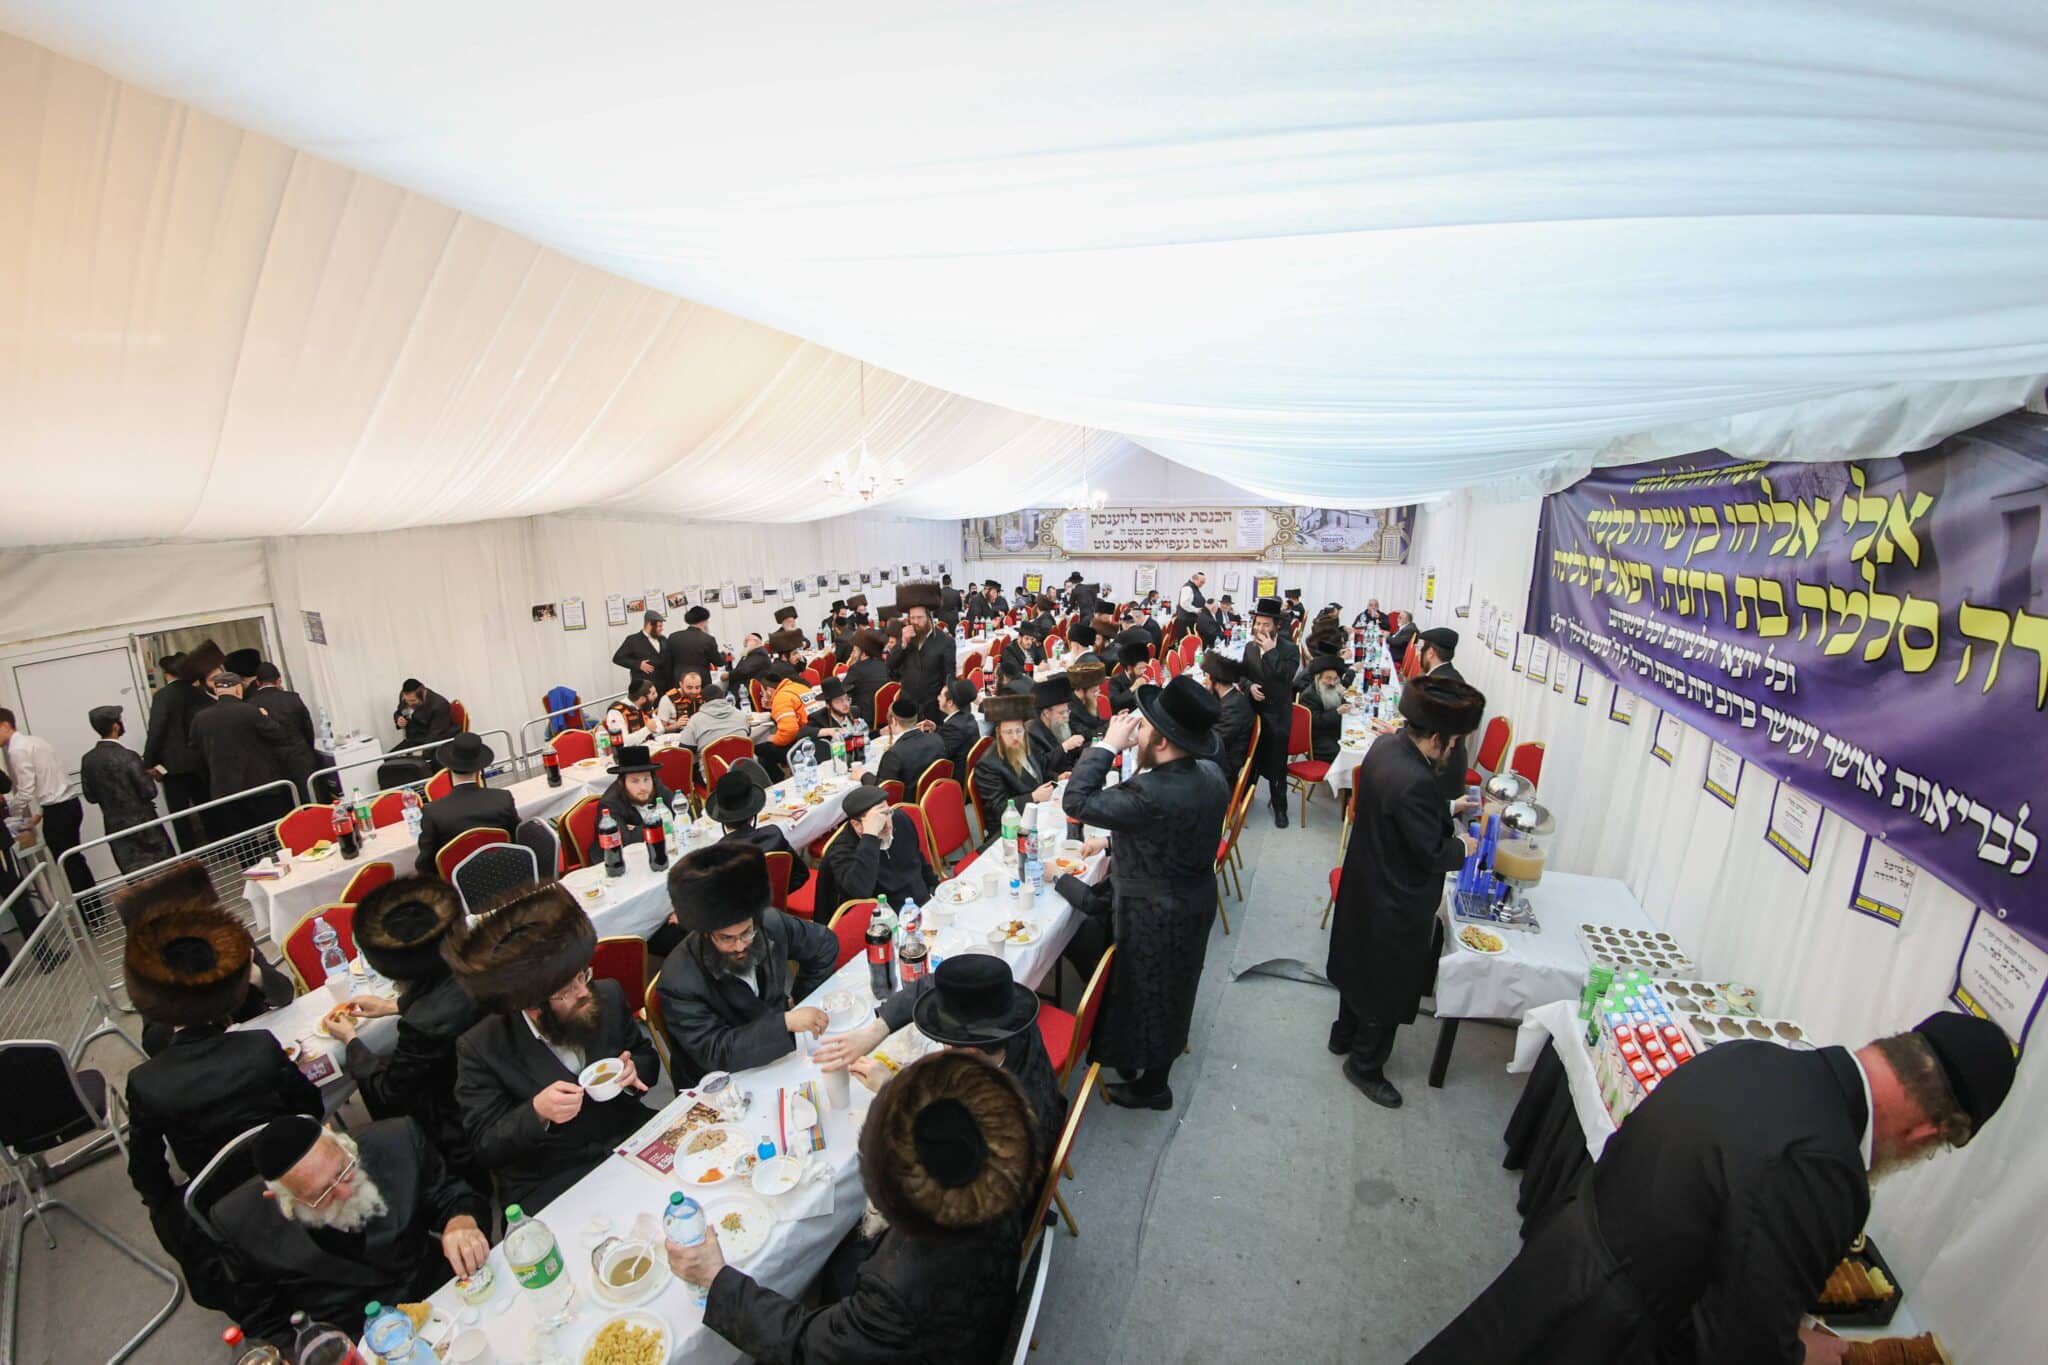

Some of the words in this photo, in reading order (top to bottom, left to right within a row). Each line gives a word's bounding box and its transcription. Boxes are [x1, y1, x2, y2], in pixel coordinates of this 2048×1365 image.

[1141, 511, 1185, 524] אורחים
[1189, 511, 1232, 523] הכנסת
[1633, 505, 1686, 550] שרה
[1684, 504, 1721, 566] בן
[1723, 475, 1831, 560] אליהו
[1841, 464, 1934, 568] אלי
[1588, 556, 1606, 600] בן
[1606, 541, 1656, 604] רפאל
[1645, 610, 1667, 645] וכל
[1735, 573, 1788, 637] בת
[1796, 557, 1939, 673] סלמה
[1687, 674, 1713, 709] נחת
[1763, 643, 1796, 695] וכל
[1715, 686, 1757, 728] ברוב
[1761, 703, 1819, 759] ועושר
[1822, 732, 1887, 798] אושר
[1891, 767, 2038, 874] לבריאות
